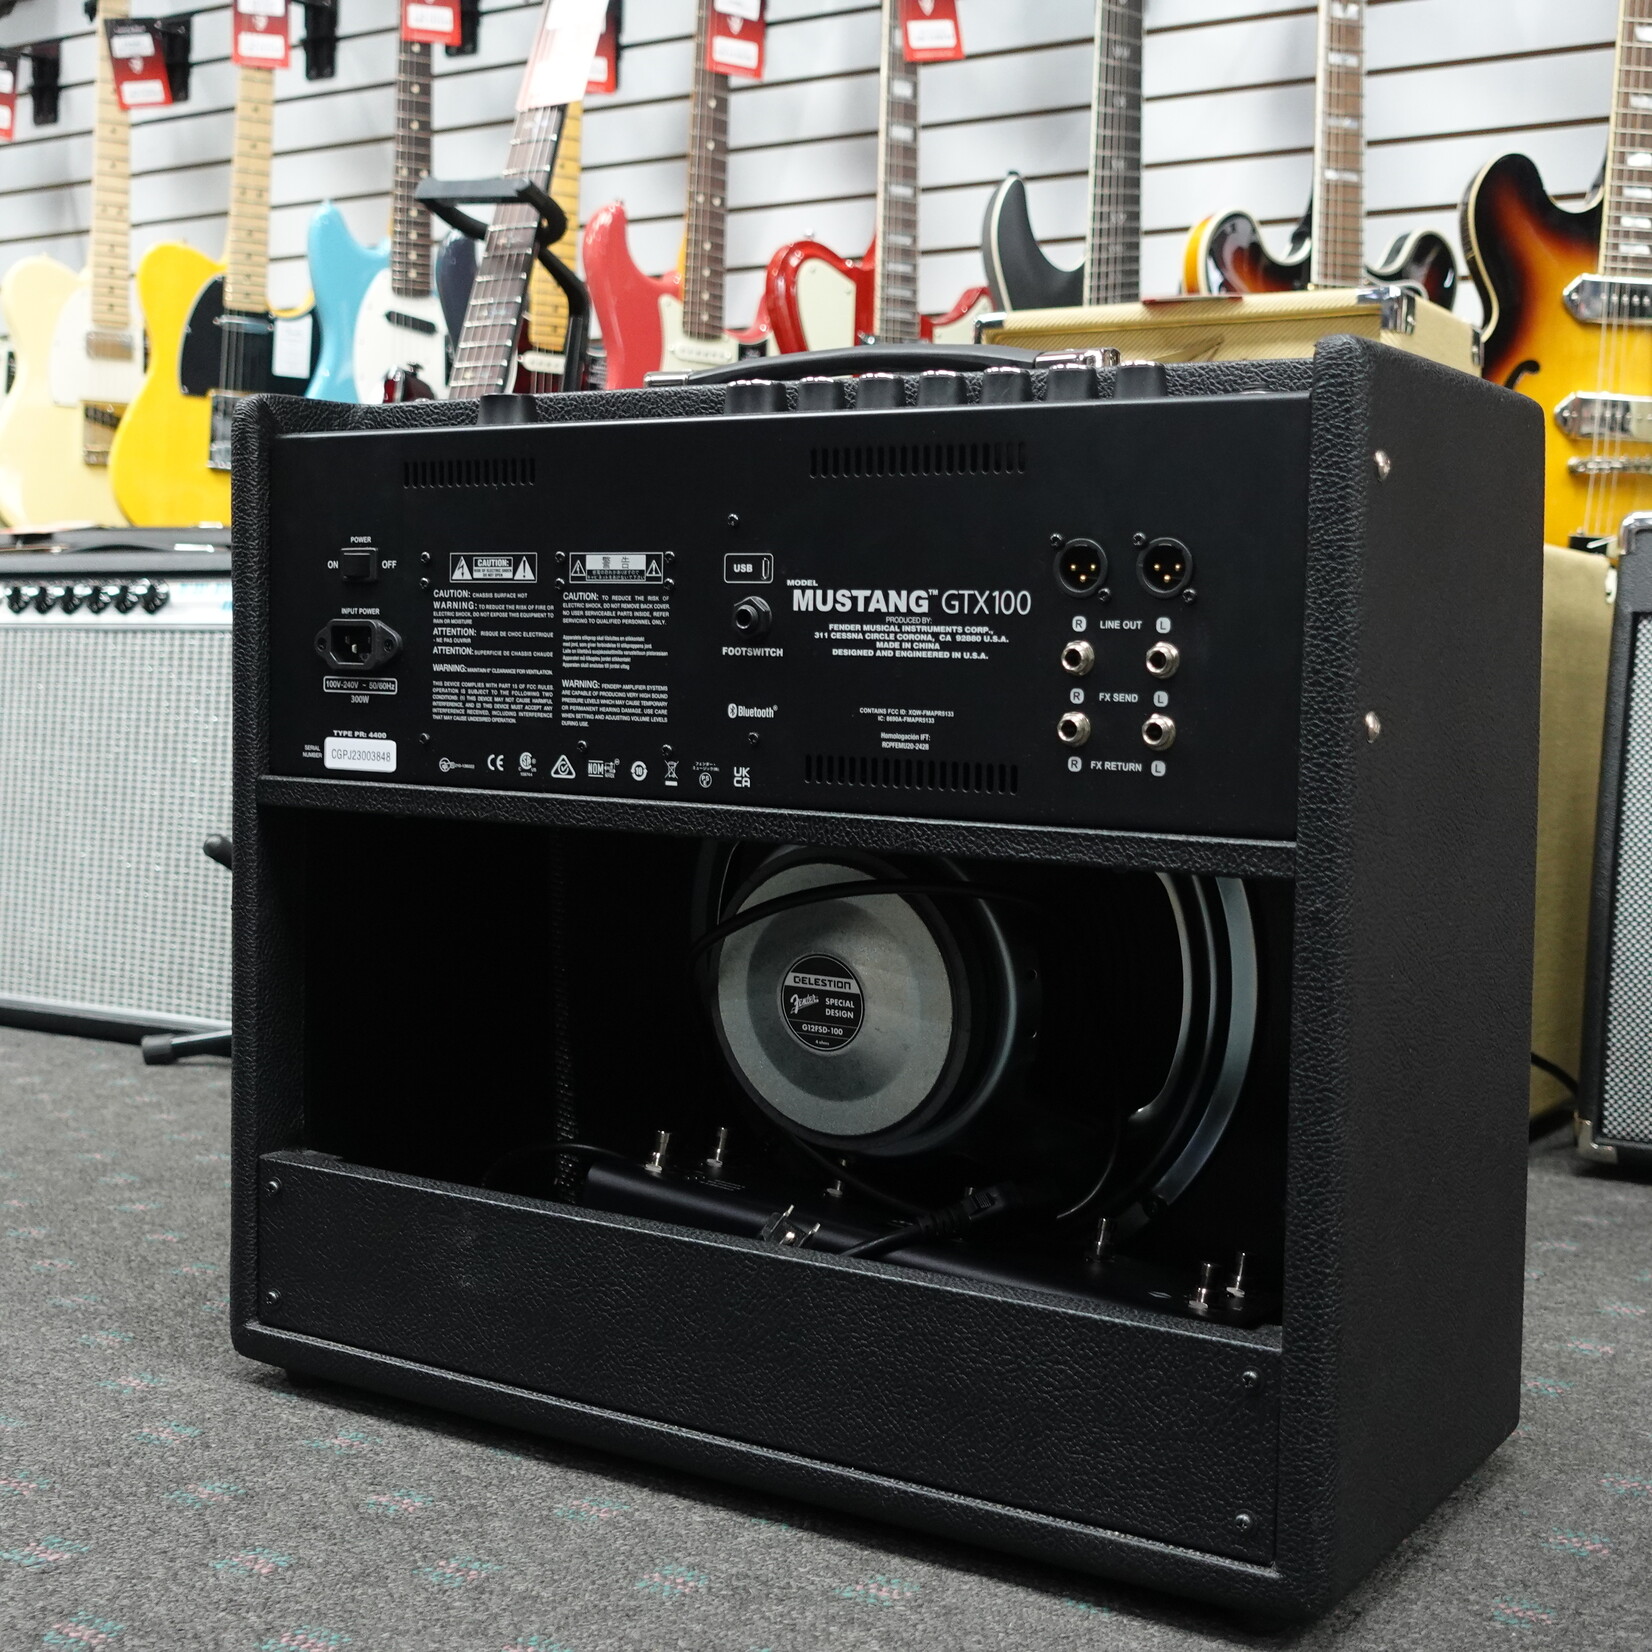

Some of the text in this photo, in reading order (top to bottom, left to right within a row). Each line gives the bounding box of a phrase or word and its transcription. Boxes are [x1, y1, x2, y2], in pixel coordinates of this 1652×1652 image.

[327, 561, 339, 569] ON
[382, 560, 397, 569] OFF
[733, 564, 753, 572] USB
[563, 592, 599, 600] CAUTION:
[433, 602, 478, 610] WARNING:
[941, 590, 1032, 615] GTX100
[902, 625, 963, 634] INSTRUMENTS
[1100, 620, 1142, 629] LINE OUT
[433, 628, 477, 636] ATTENTION:
[433, 646, 474, 655] ATTENTION:
[722, 646, 783, 657] FOOTSWITCH
[895, 650, 950, 658] ENGINEERED
[326, 680, 358, 689] 100V-240V
[1099, 693, 1139, 703] FX SEND
[331, 750, 390, 762] CGPJ23003848
[487, 754, 504, 771] CE
[1090, 761, 1142, 772] FX RETURN
[734, 767, 750, 777] UK
[733, 777, 751, 787] CA
[793, 976, 851, 990] CELESTION
[825, 998, 855, 1008] SPECIAL
[825, 1008, 854, 1019] DESIGN
[802, 1024, 843, 1035] G12FSD-100
